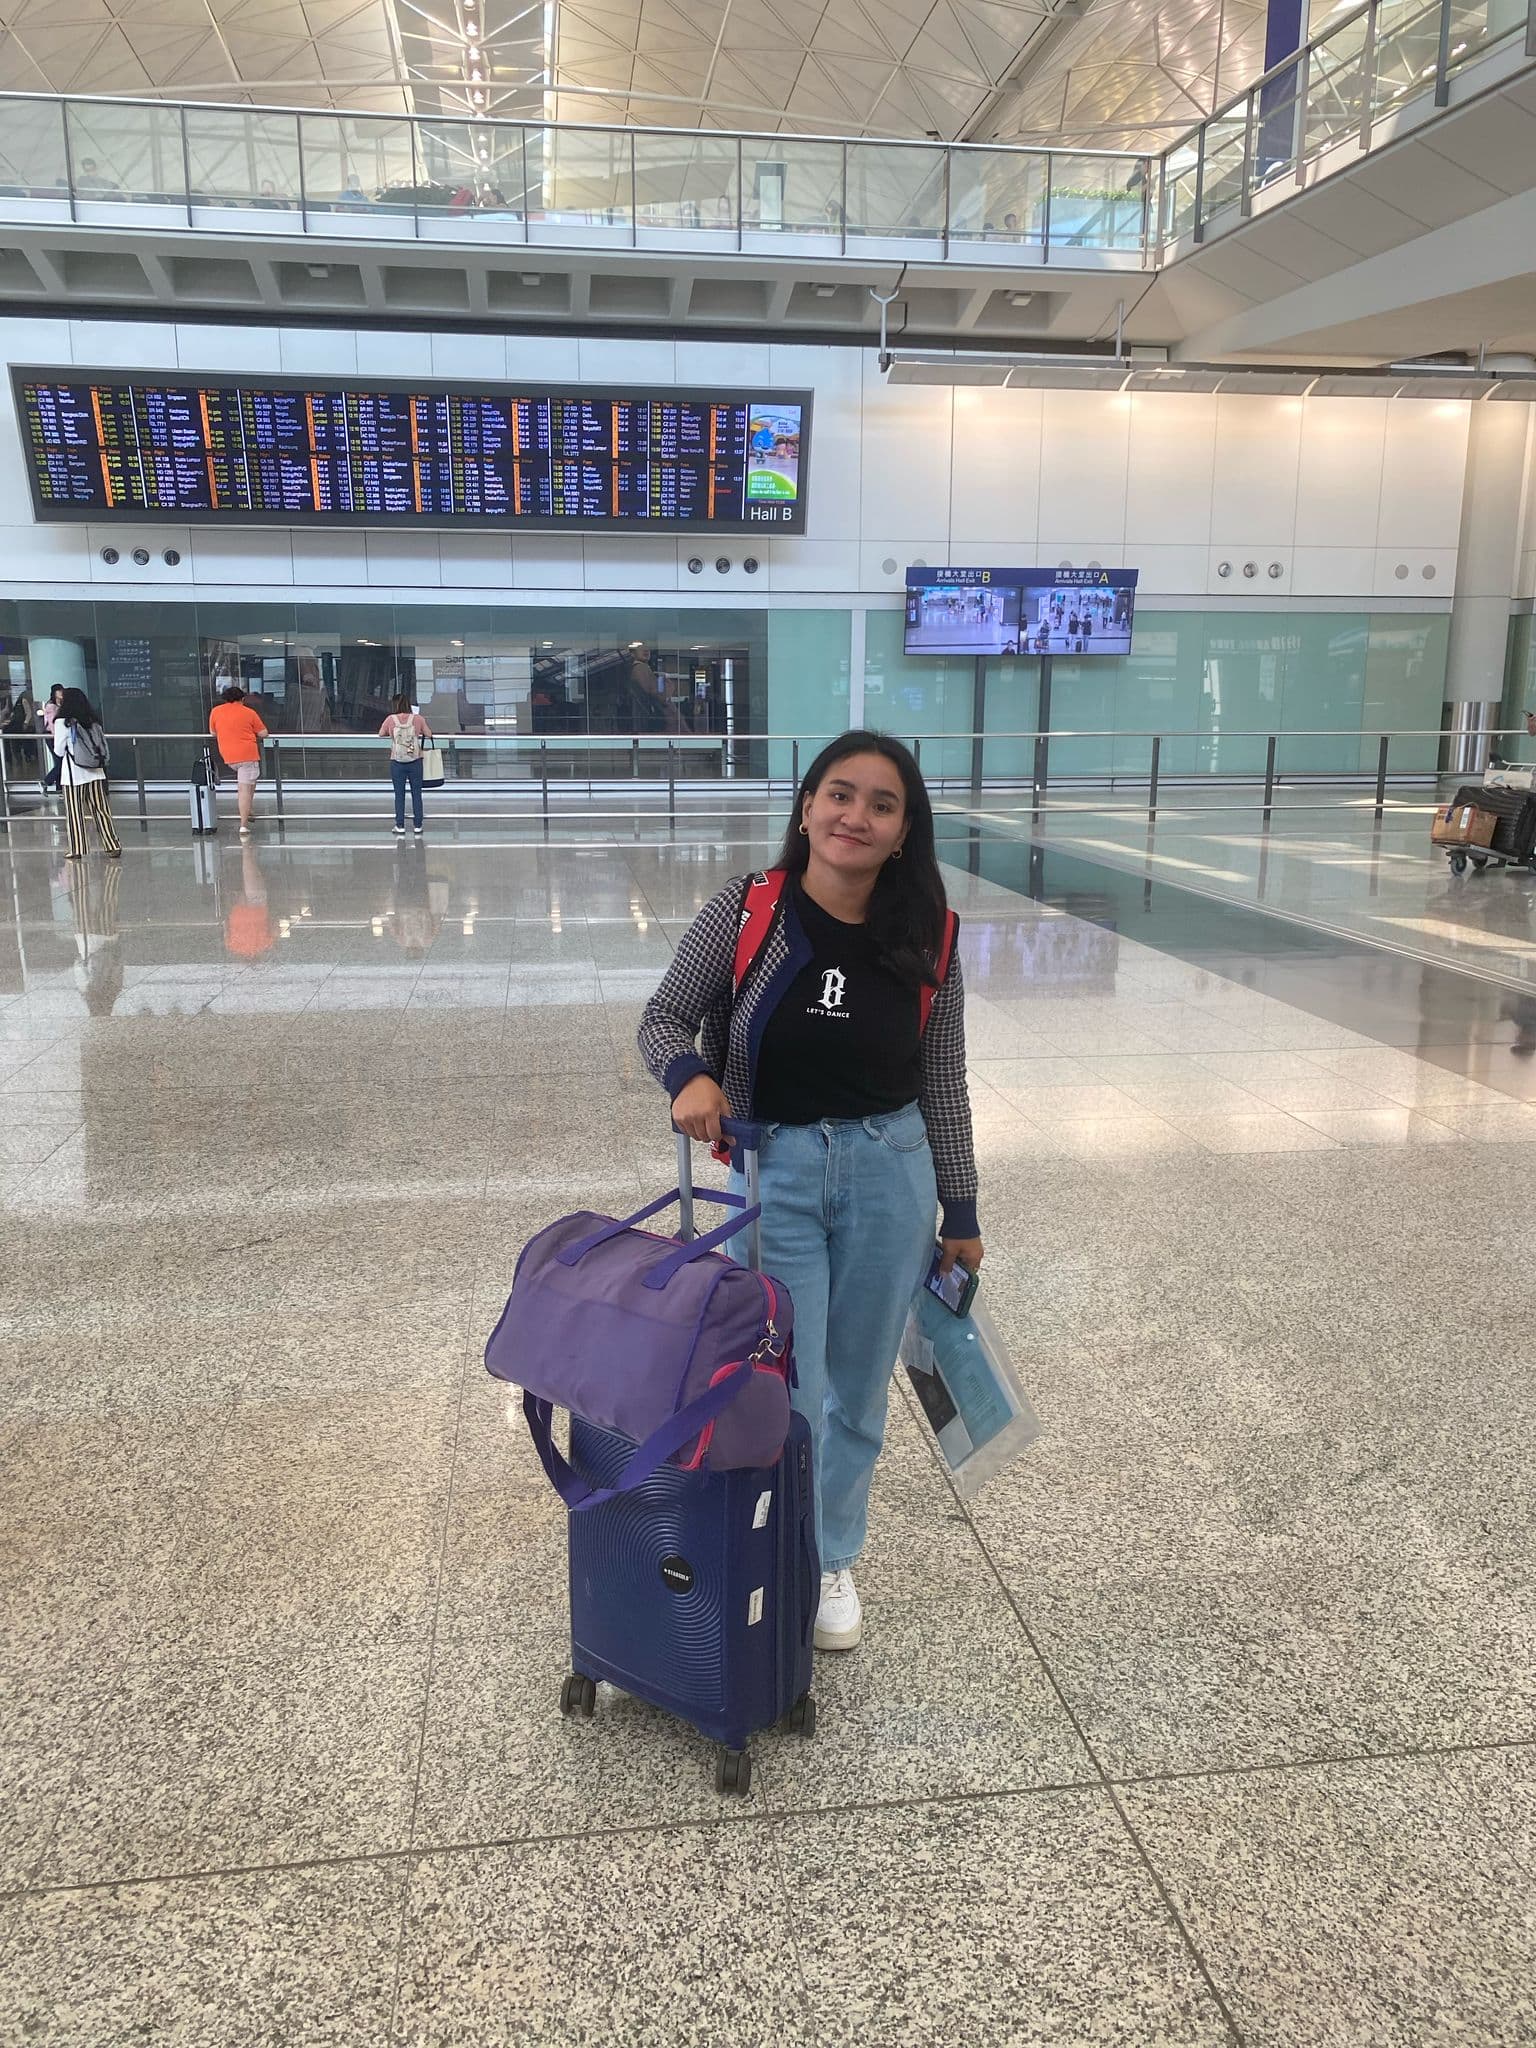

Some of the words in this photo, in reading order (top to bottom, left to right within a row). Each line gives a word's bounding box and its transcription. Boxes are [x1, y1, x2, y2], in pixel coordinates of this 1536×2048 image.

[750, 507, 777, 520] Hall
[782, 508, 792, 520] B
[982, 571, 991, 583] B
[1098, 572, 1109, 584] A
